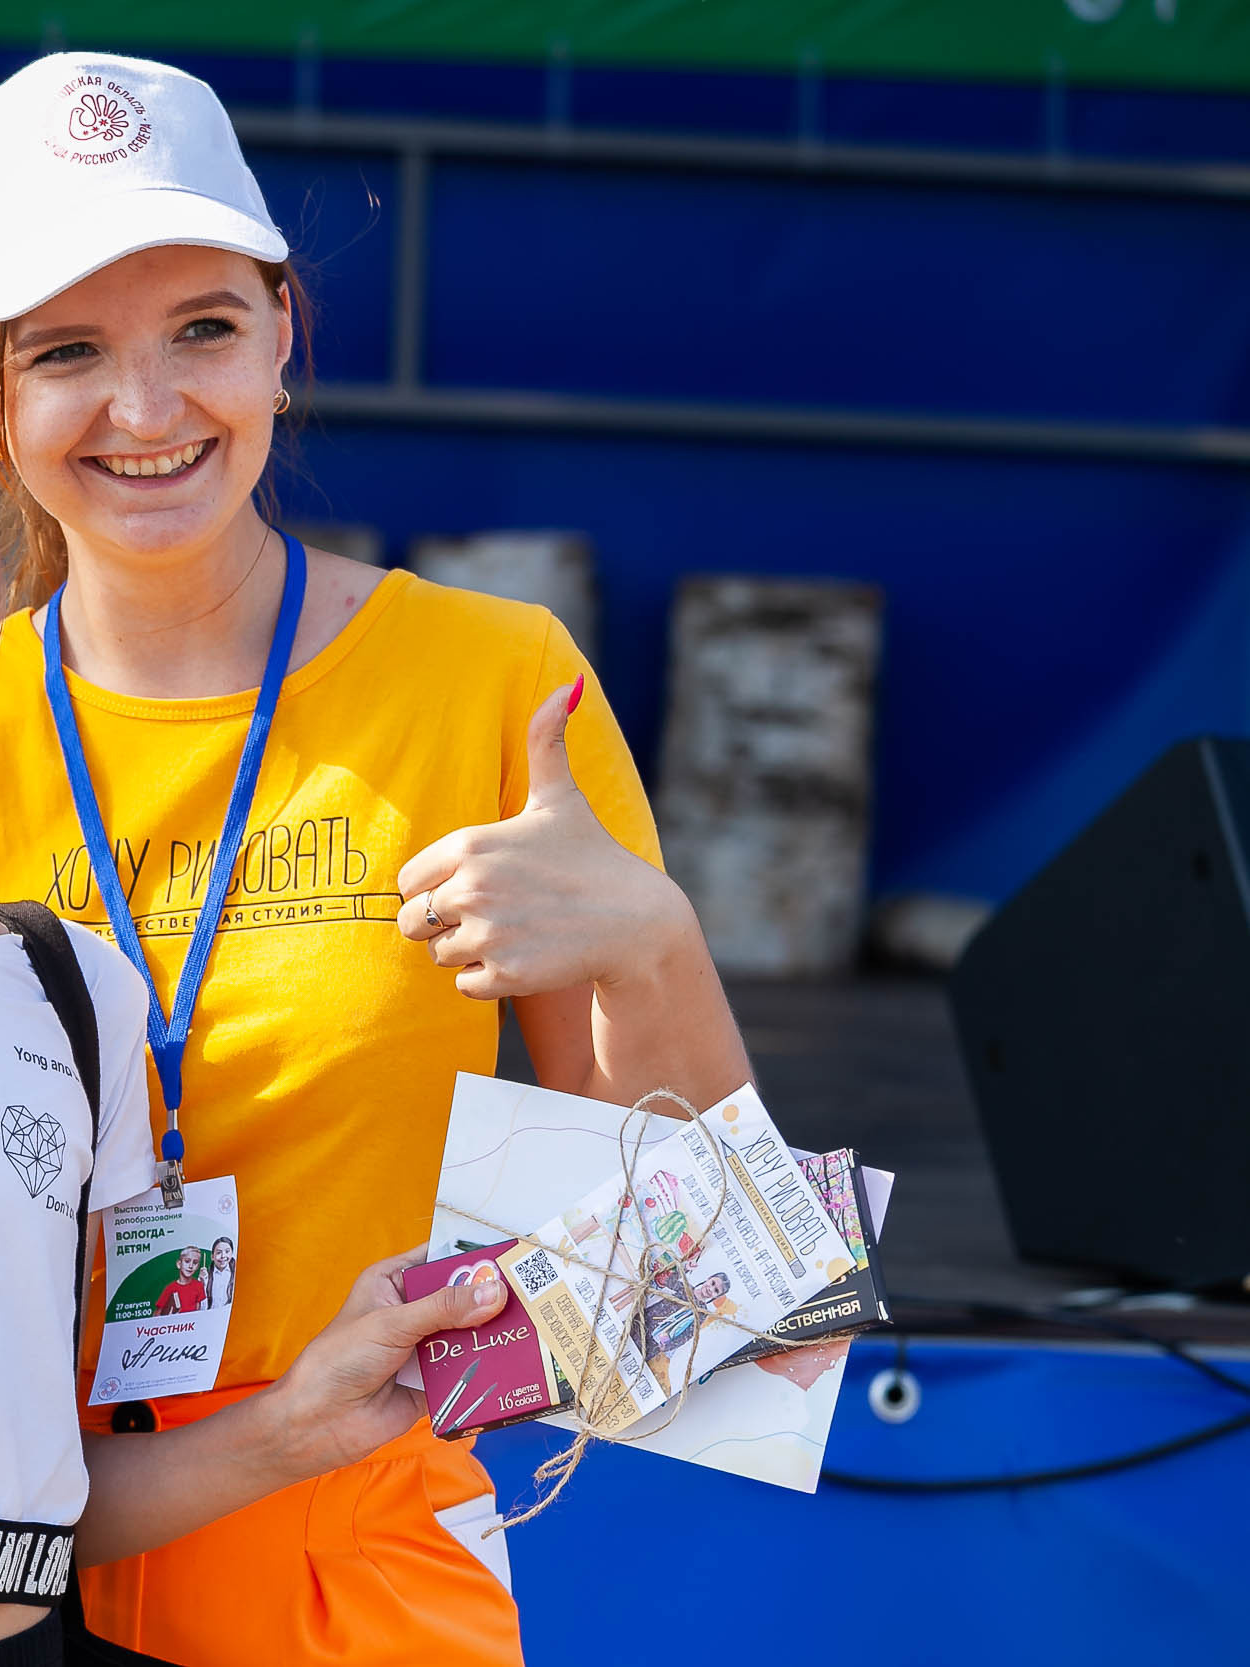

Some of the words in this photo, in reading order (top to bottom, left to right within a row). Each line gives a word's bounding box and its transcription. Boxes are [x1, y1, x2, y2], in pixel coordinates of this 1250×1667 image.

[107, 81, 148, 115] ОБЛАСТЬ
[70, 148, 128, 165] РУССКОГО
[127, 123, 152, 153] СЕВЕРА
[44, 838, 150, 911] ХОУ
[252, 904, 323, 922] СТУДИЯ
[13, 1045, 48, 1071] Yong
[740, 1130, 786, 1178] ХОЧУ
[764, 1172, 828, 1256] РИСОВАТЬ
[114, 1205, 153, 1214] Выставка
[114, 1213, 183, 1226] допобразования
[116, 1229, 165, 1241] ВОЛОГДА
[769, 1225, 789, 1252] СТУДИЯ
[116, 1243, 151, 1256] ДЕТЯМ
[115, 1309, 152, 1319] 11:00-15:00
[116, 1303, 123, 1311] 27
[125, 1302, 150, 1311] августа
[136, 1322, 195, 1337] Участник
[122, 1338, 209, 1371] Арина
[425, 1339, 464, 1363] De
[472, 1326, 530, 1352] Luxe
[621, 1356, 655, 1400] ТВОРЕСТВО
[498, 1392, 513, 1411] 16
[512, 1383, 540, 1396] цветов
[515, 1394, 542, 1407] colours
